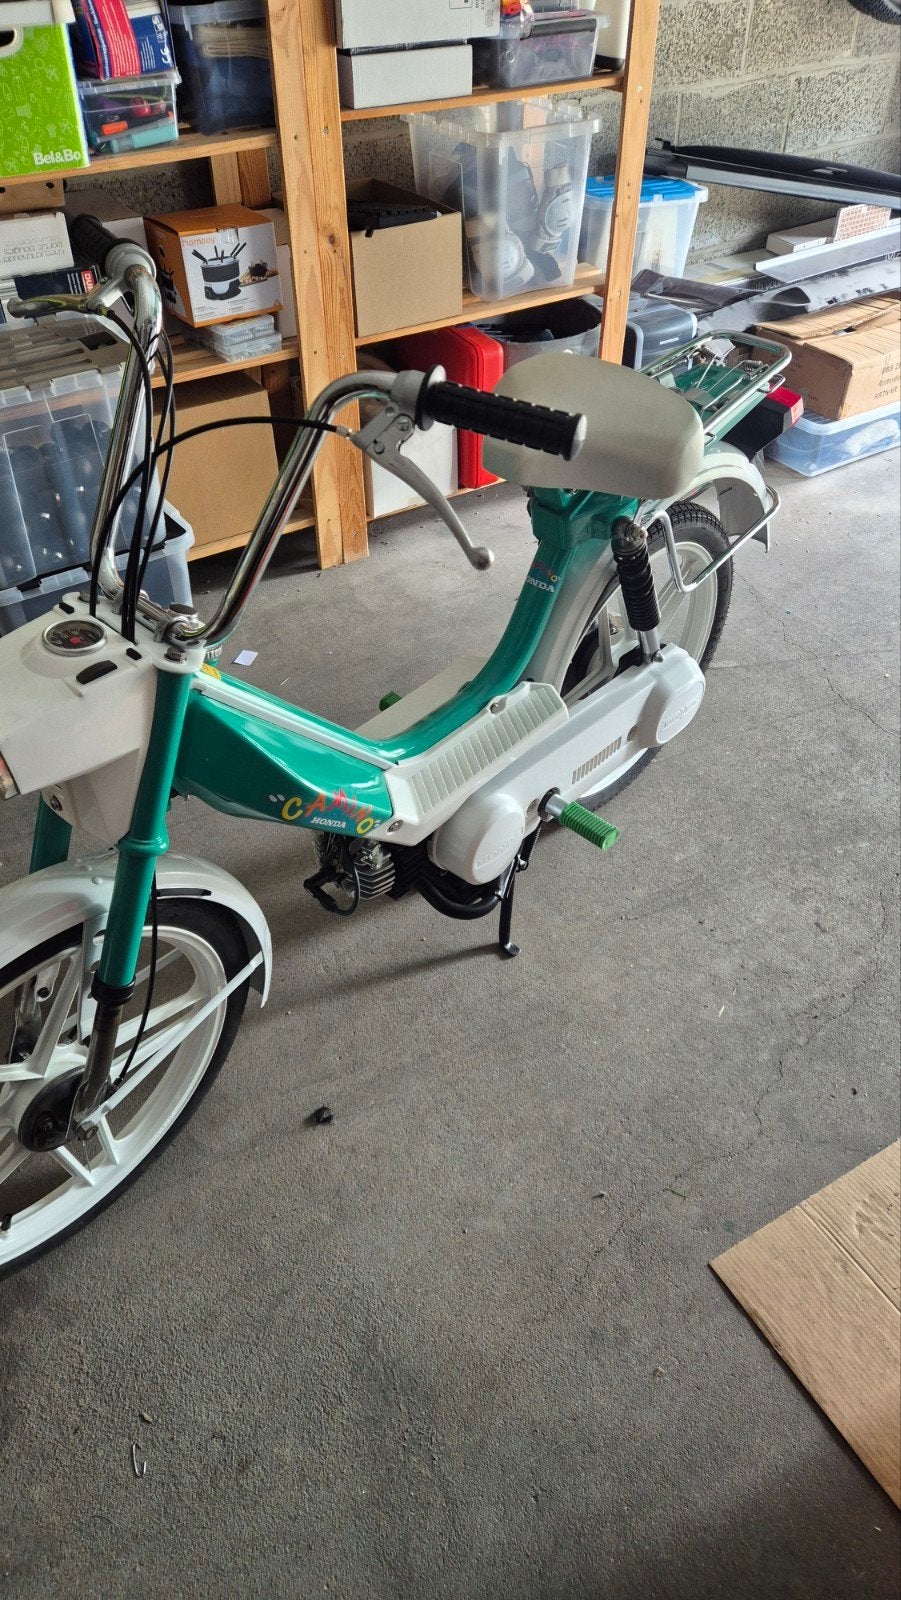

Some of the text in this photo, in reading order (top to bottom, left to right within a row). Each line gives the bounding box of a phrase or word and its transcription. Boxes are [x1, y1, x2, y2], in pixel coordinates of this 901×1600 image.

[32, 149, 81, 166] Bel&Bo
[281, 789, 375, 835] CAMINO
[310, 816, 347, 829] HONDA
